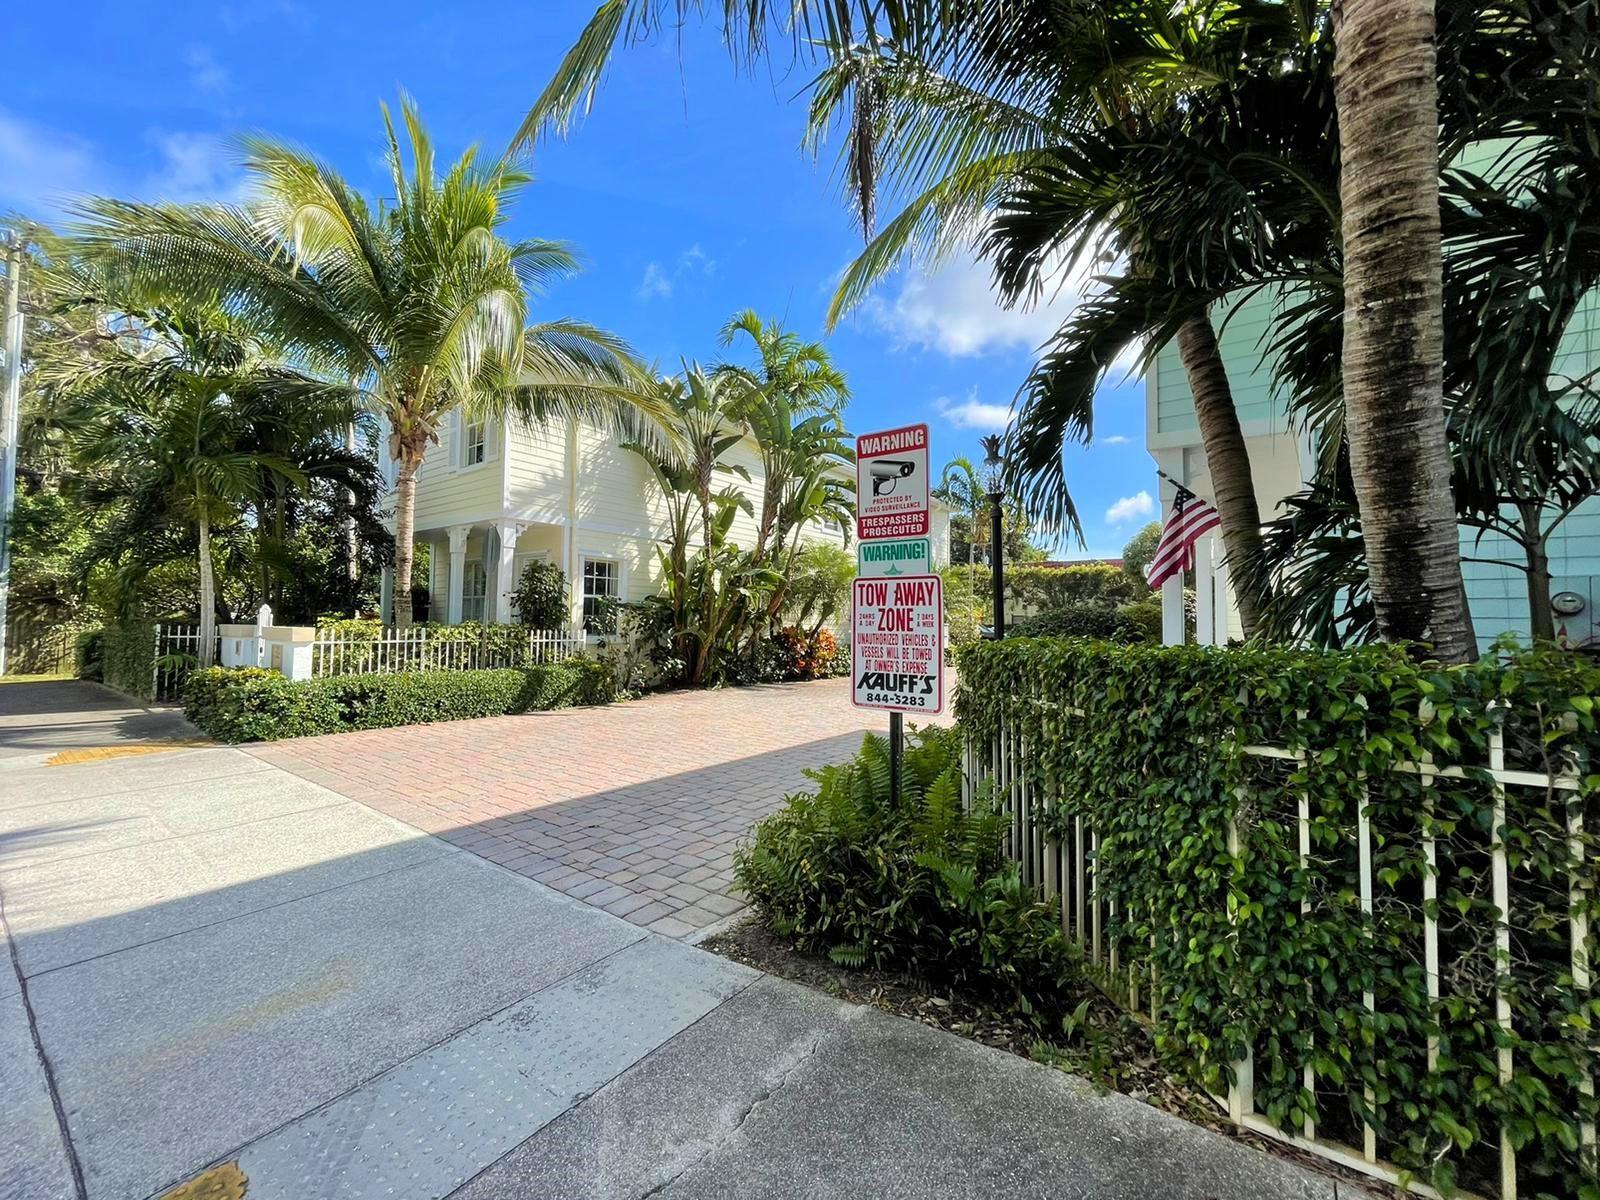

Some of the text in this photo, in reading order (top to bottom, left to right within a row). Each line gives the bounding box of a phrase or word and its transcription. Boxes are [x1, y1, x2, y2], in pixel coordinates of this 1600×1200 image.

[860, 430, 924, 454] WARNING
[872, 496, 902, 504] PROTECTED
[882, 502, 920, 511] SURVEILLANCE
[862, 513, 924, 527] TRESPASSERS
[864, 524, 922, 536] PROSECUTED
[863, 543, 925, 561] WARNING!
[858, 582, 934, 606] TOW AWAY
[878, 608, 913, 632] ZONE
[858, 633, 898, 645] UNAUTHORIZED
[902, 635, 928, 646] VEHICLES
[862, 646, 932, 660] VESSELS WILL BE TOWED
[865, 660, 927, 674] AT OWNER'S EXPENSE
[857, 672, 936, 694] KAUFF'S
[866, 694, 925, 706] 844-5283
